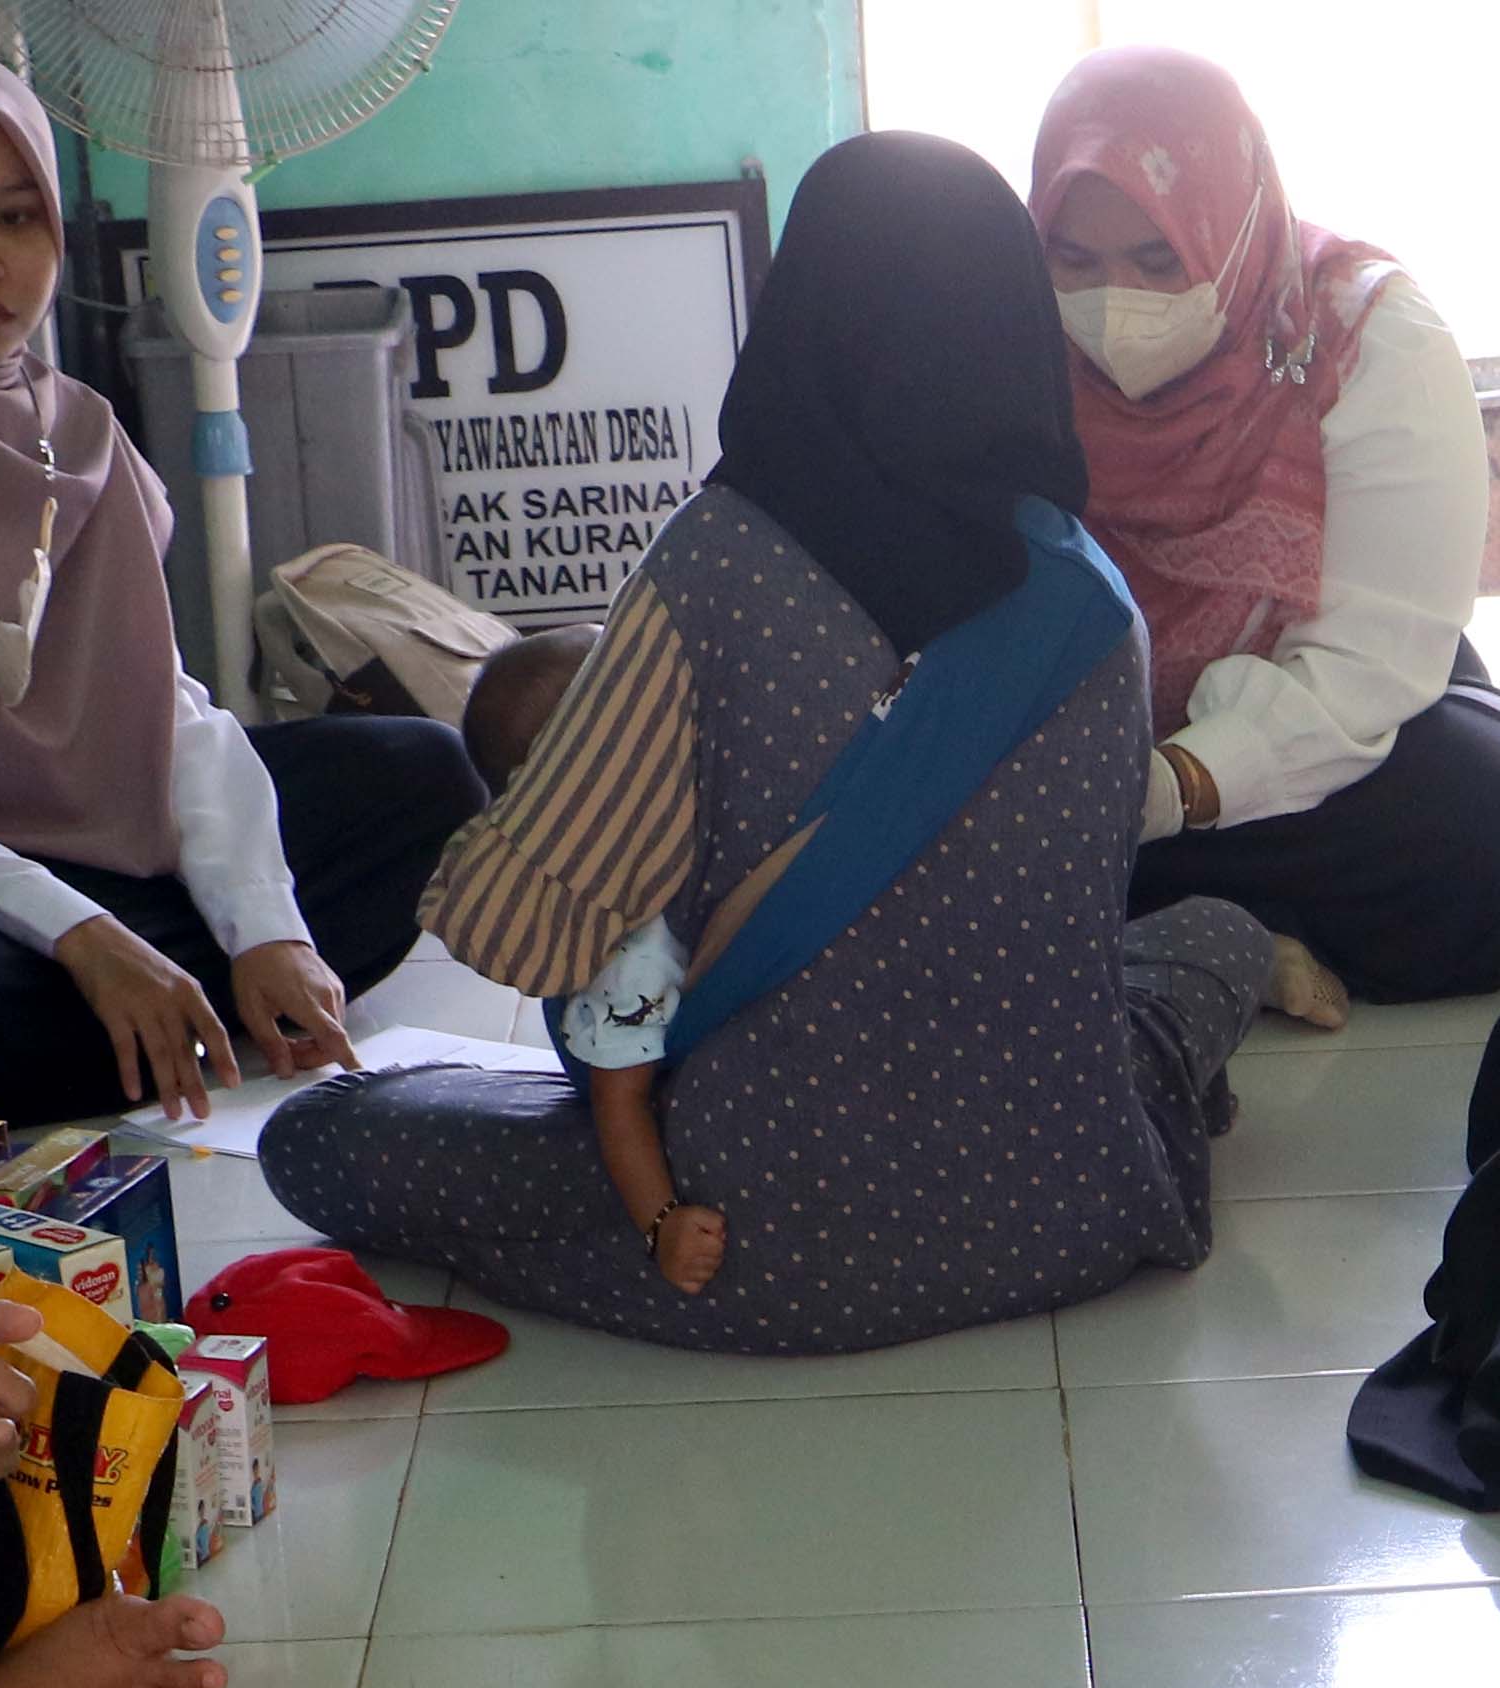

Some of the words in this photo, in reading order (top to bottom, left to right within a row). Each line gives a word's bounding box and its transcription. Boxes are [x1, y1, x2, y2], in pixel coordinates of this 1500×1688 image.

[313, 269, 567, 399] PD
[429, 410, 598, 473] YAWARATAN
[605, 405, 678, 462] DESA
[442, 491, 510, 525] AK
[446, 529, 510, 563] AN
[466, 561, 607, 600] TANAH
